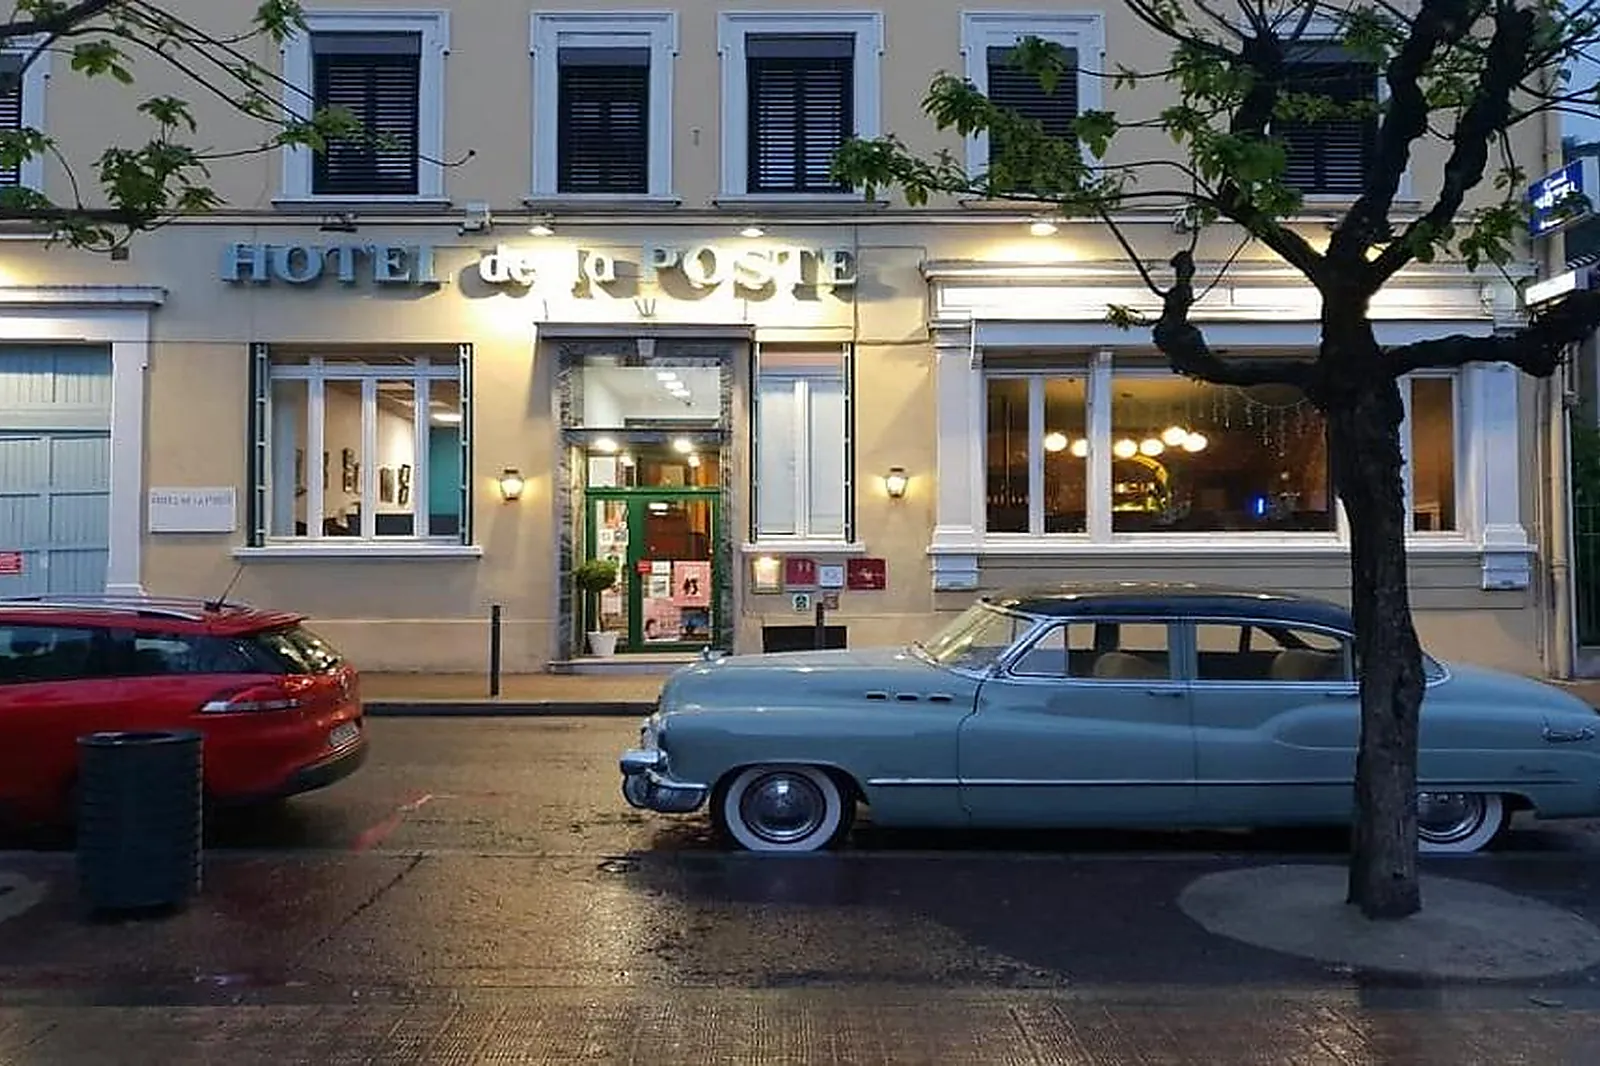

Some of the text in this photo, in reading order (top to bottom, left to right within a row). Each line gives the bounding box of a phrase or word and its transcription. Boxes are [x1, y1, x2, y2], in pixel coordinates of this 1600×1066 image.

[222, 242, 451, 283] HOTEL
[480, 244, 537, 286] de
[642, 241, 857, 288] POSTE
